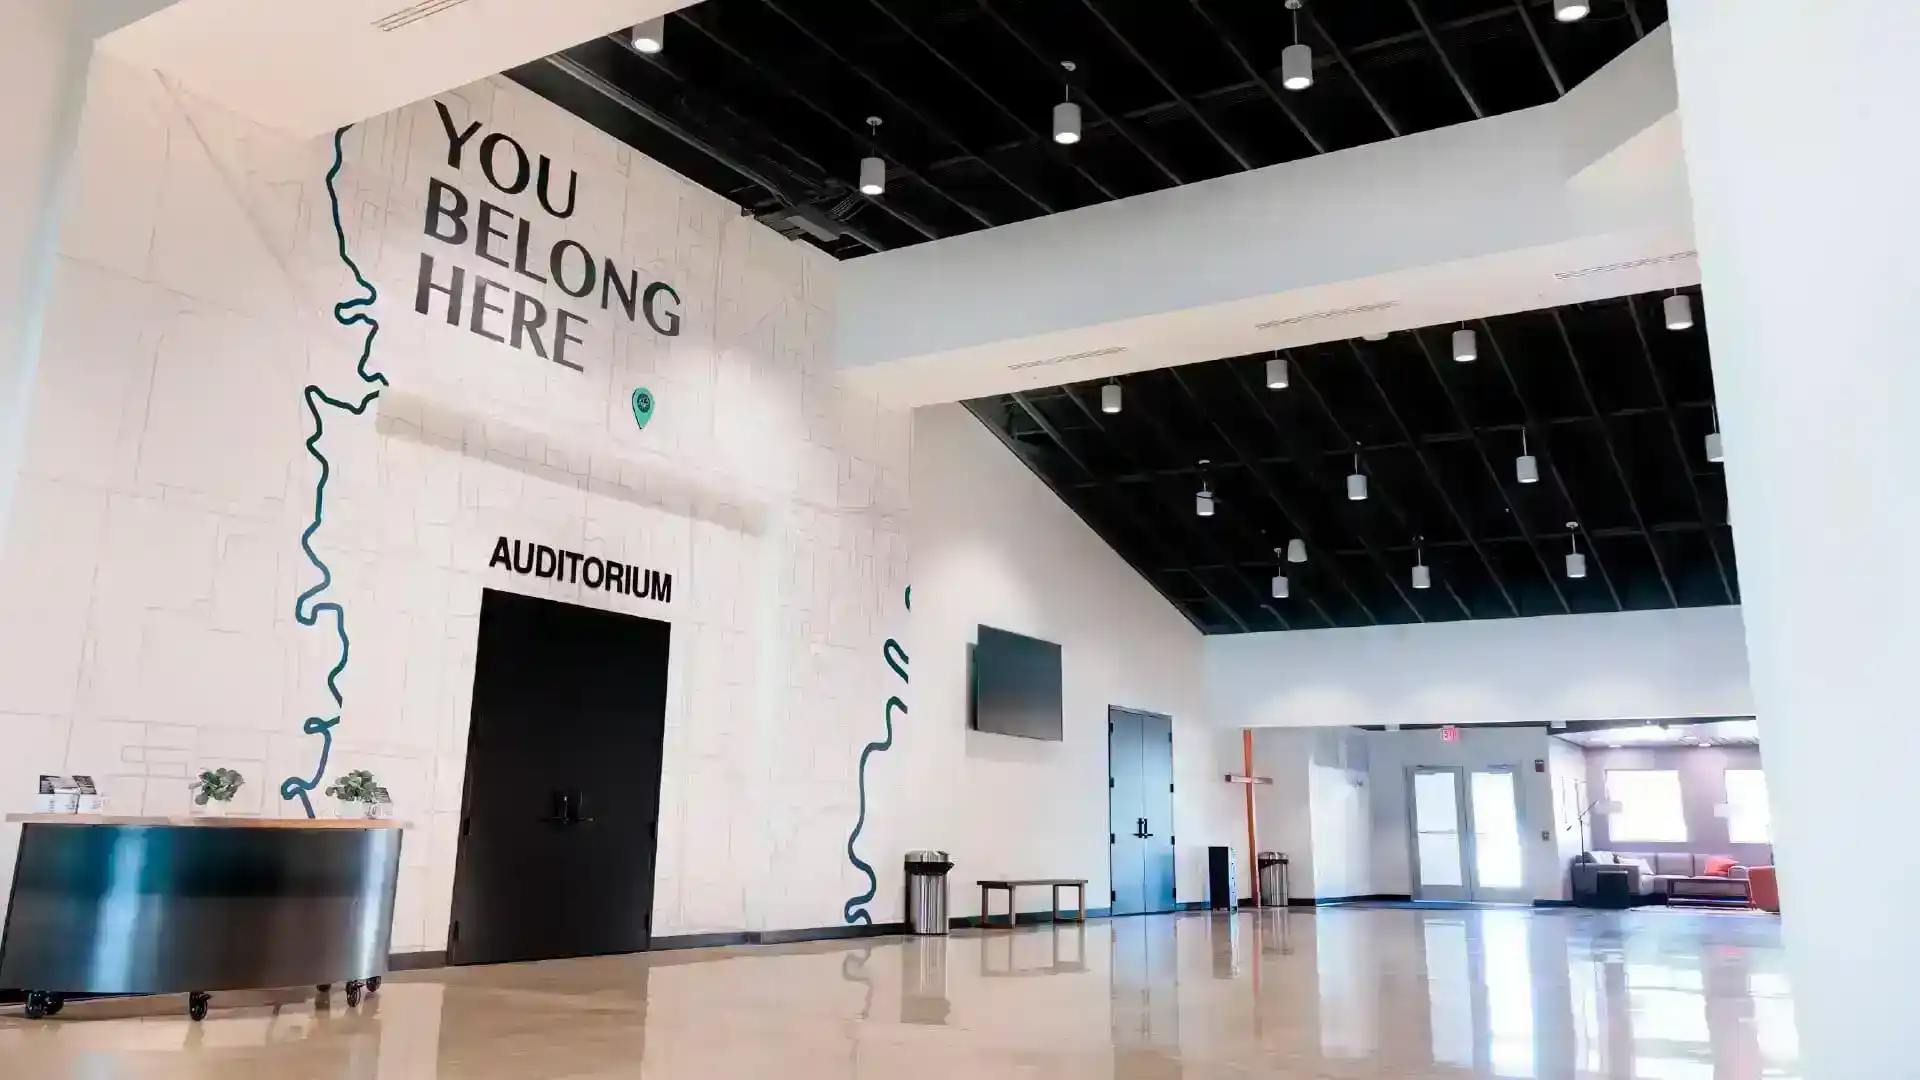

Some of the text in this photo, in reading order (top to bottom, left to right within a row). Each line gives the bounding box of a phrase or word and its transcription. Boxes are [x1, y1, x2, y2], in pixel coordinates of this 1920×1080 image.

[433, 99, 578, 219] YOU
[414, 252, 586, 373] HERE
[423, 176, 681, 337] BELONG
[488, 535, 672, 604] AUDITORIUM
